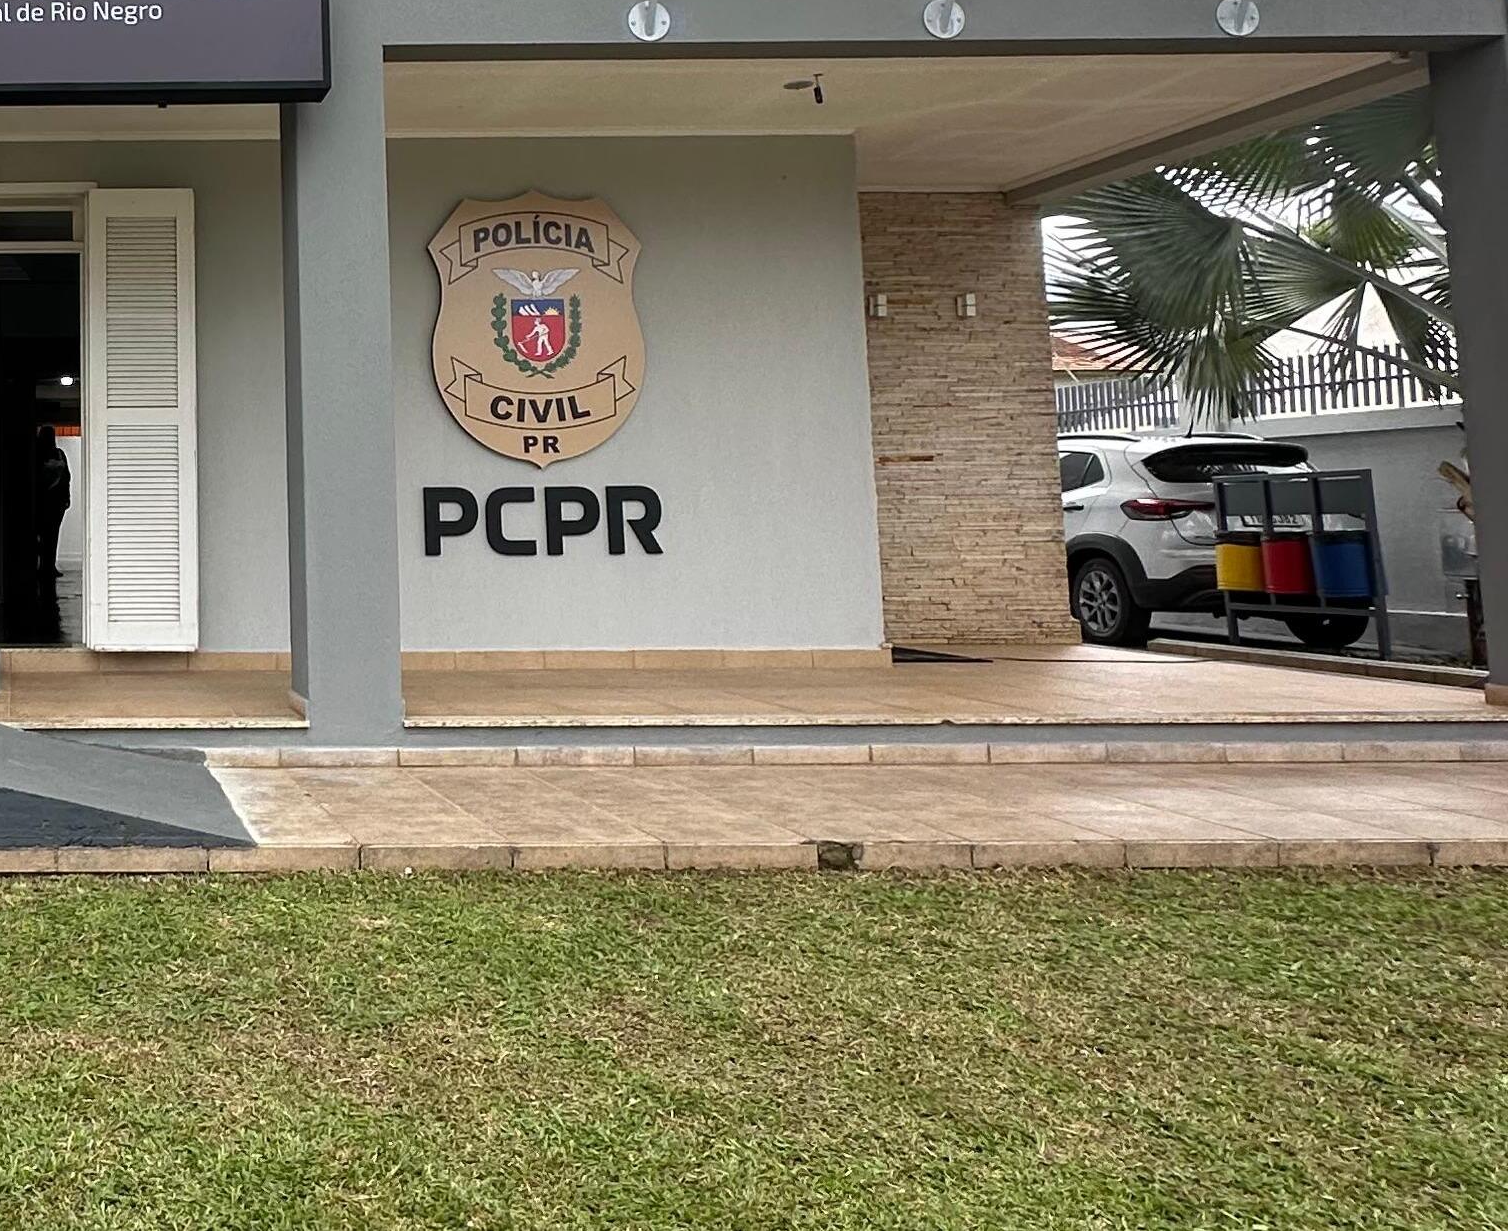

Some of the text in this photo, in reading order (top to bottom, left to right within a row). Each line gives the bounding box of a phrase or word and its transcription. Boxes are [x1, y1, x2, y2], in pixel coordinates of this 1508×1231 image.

[15, 1, 45, 22] de
[50, 0, 86, 21] Rio
[93, 0, 163, 26] Negro
[472, 215, 596, 253] POLÍCIA
[489, 395, 591, 423] CIVIL
[522, 435, 560, 454] PR
[422, 485, 664, 556] PCPR
